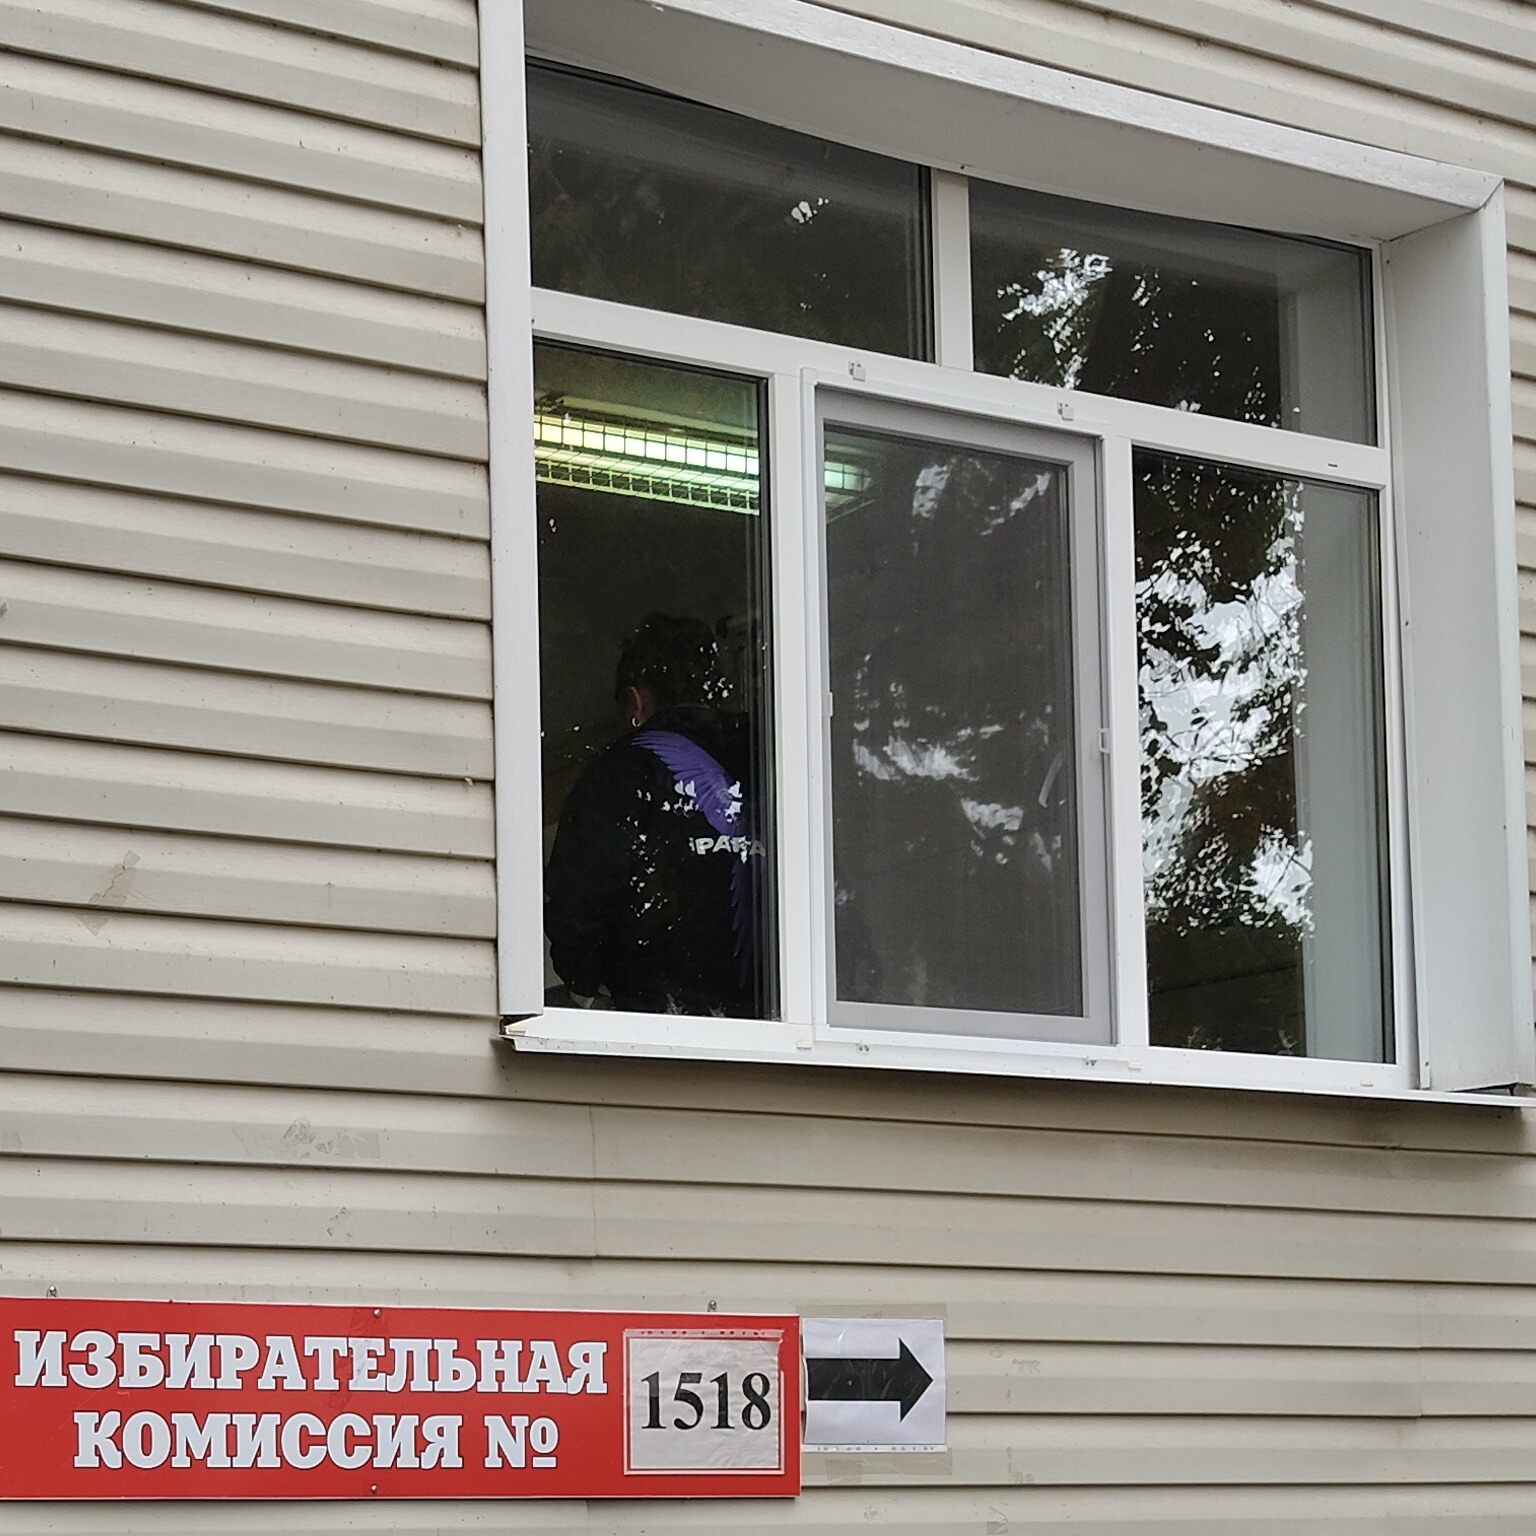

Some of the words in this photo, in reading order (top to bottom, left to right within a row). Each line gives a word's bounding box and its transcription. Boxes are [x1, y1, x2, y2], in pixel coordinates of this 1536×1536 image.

[13, 1329, 609, 1396] ИЗБИРАТЕЛЬНАЯ
[639, 1370, 773, 1432] 1518
[72, 1409, 464, 1471] КОМИССИЯ
